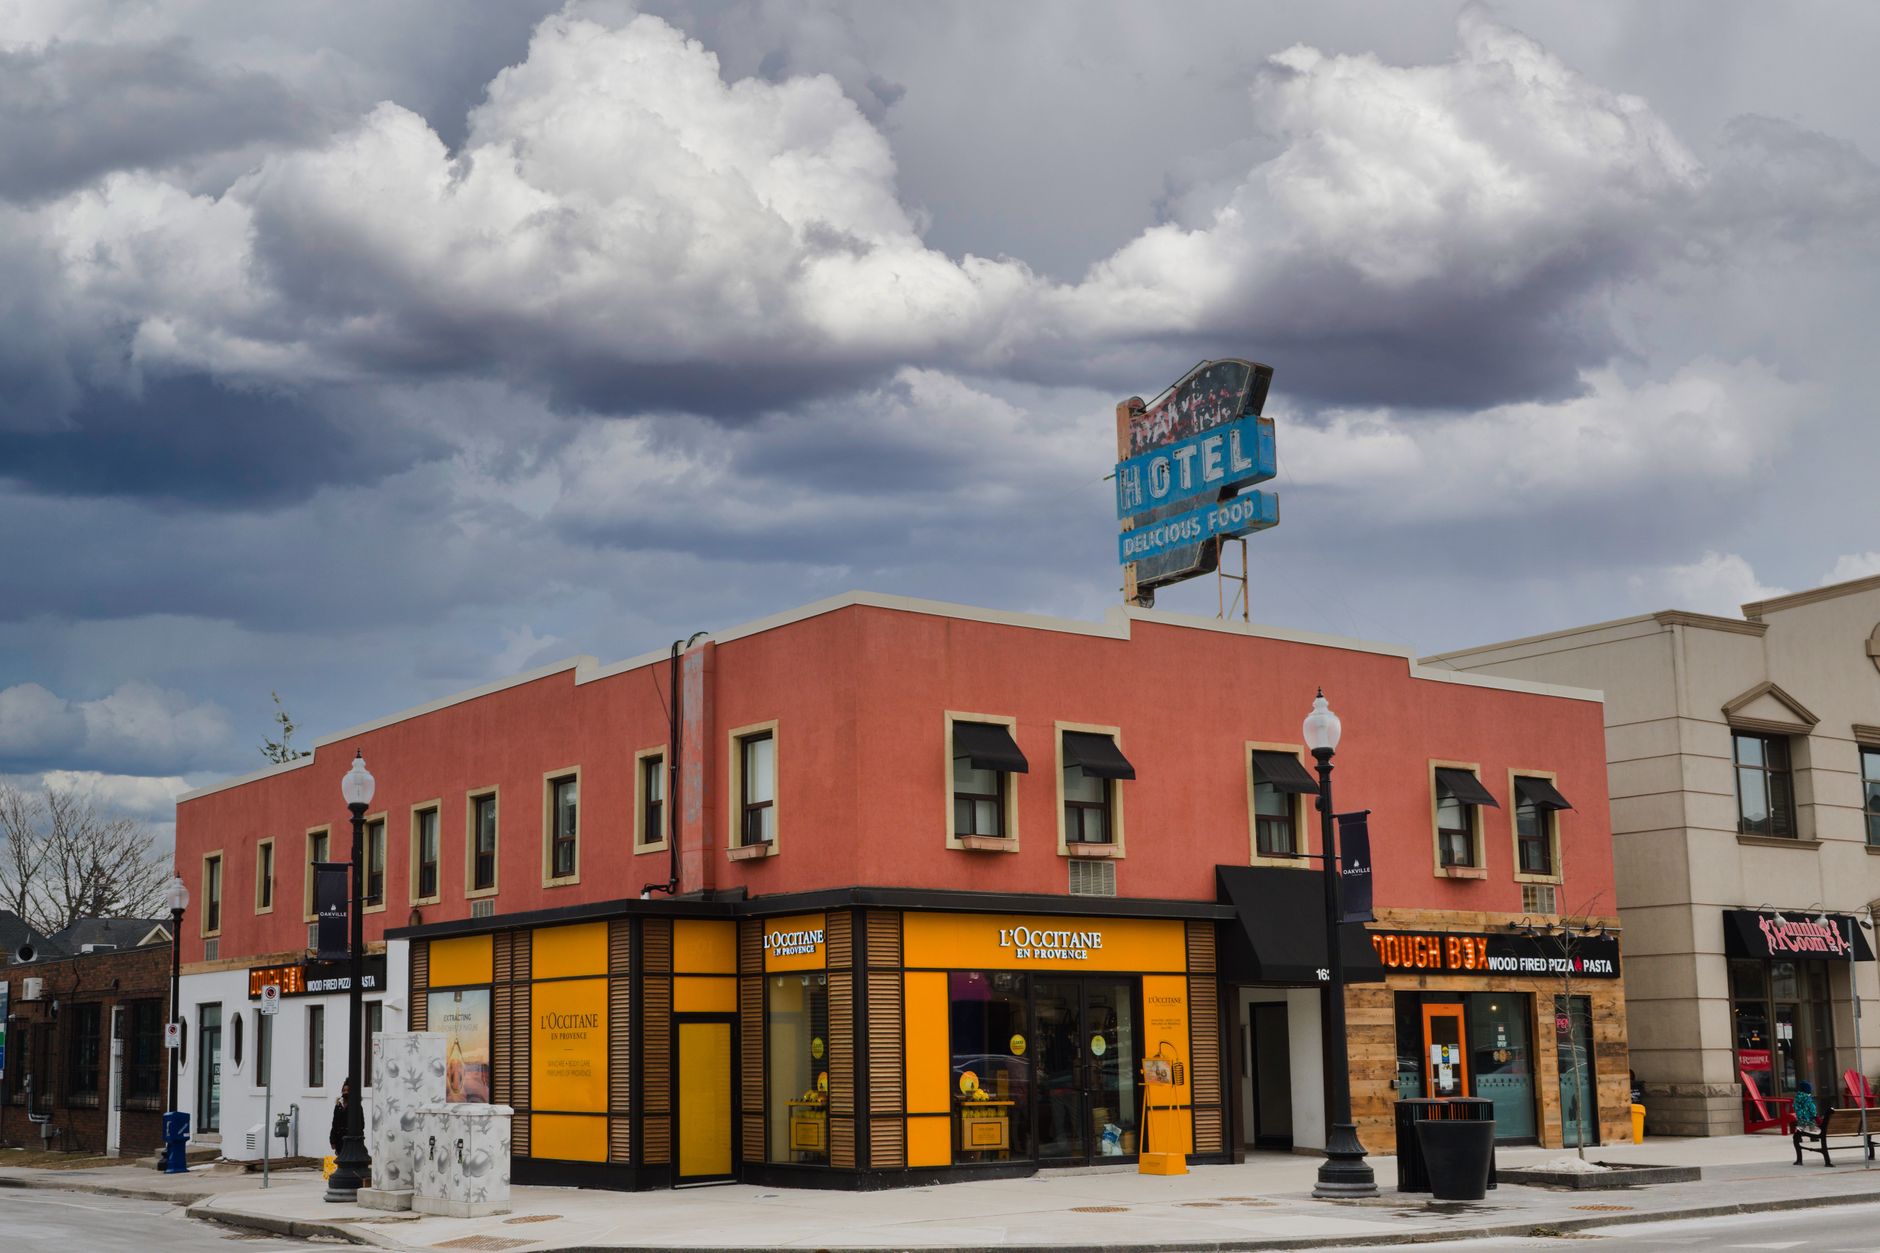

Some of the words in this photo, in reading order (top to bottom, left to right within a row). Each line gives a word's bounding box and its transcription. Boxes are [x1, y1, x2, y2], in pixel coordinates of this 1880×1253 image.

[1119, 428, 1252, 511] HOTEL
[1123, 516, 1201, 556] DELICIOUS
[1207, 500, 1254, 531] FOOD
[1343, 867, 1371, 875] OAKVILLE
[782, 945, 815, 956] PROVENCE
[1016, 948, 1031, 958] EN
[1034, 949, 1088, 959] PROVENCE
[1445, 936, 1489, 970] BOX
[1488, 957, 1518, 971] WOOD
[1520, 958, 1547, 971] FIRED
[1548, 958, 1575, 972] PIZZA
[1583, 959, 1613, 973] PASTA
[282, 966, 305, 993] BOX
[307, 980, 322, 992] WOOD
[323, 978, 338, 991] FIRED
[338, 977, 352, 989] PIZZ
[361, 975, 376, 988] ASTA
[551, 1032, 558, 1041] EN
[559, 1032, 587, 1040] PROVENCE
